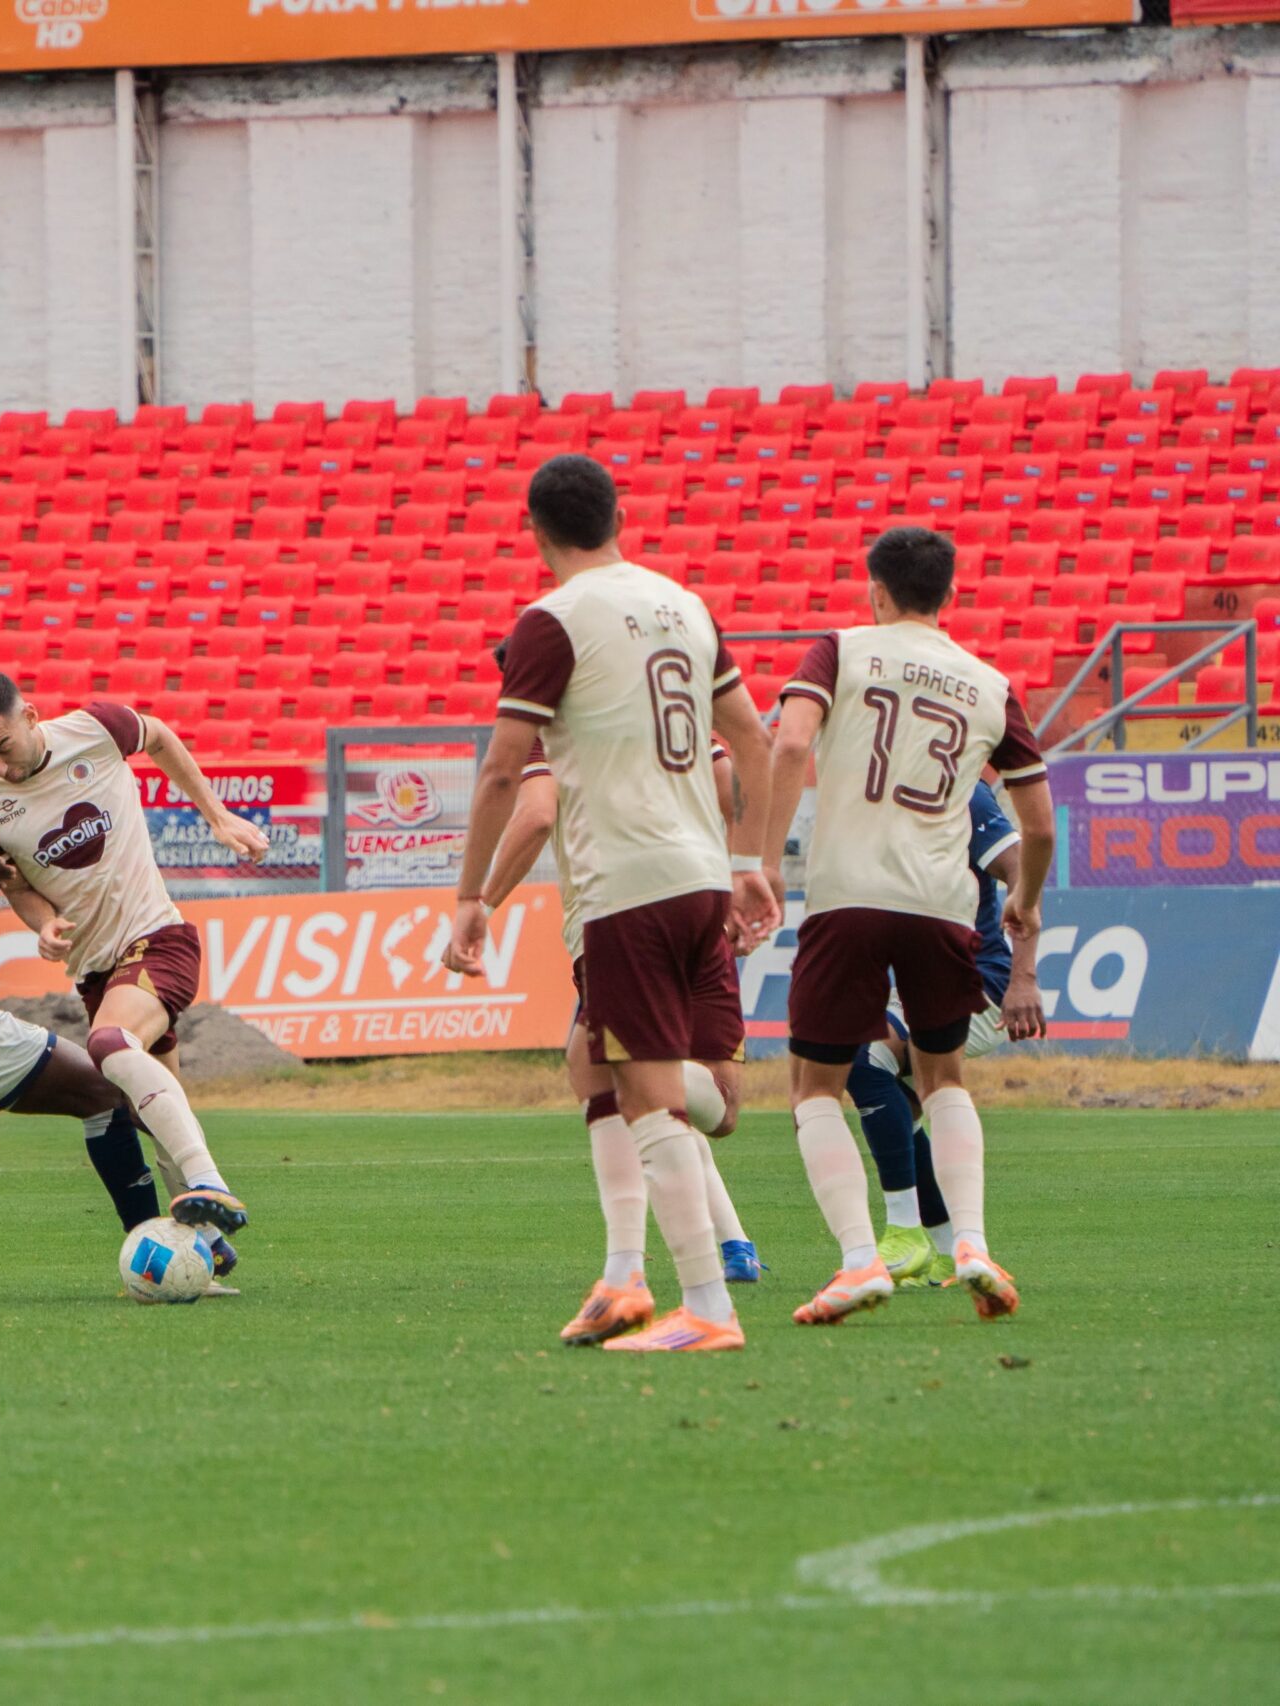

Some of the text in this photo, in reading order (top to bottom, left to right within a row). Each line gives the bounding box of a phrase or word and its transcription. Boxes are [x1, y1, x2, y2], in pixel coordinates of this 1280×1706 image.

[35, 23, 84, 49] HD
[1213, 591, 1239, 617] 40
[870, 656, 980, 707] R. GARCES
[646, 648, 697, 774] 6
[863, 686, 969, 815] 13
[146, 776, 163, 803] Y
[166, 775, 274, 803] SEUROS
[1085, 761, 1280, 804] SUP
[318, 1013, 342, 1043] &
[351, 1001, 513, 1043] TELEVISIÓN
